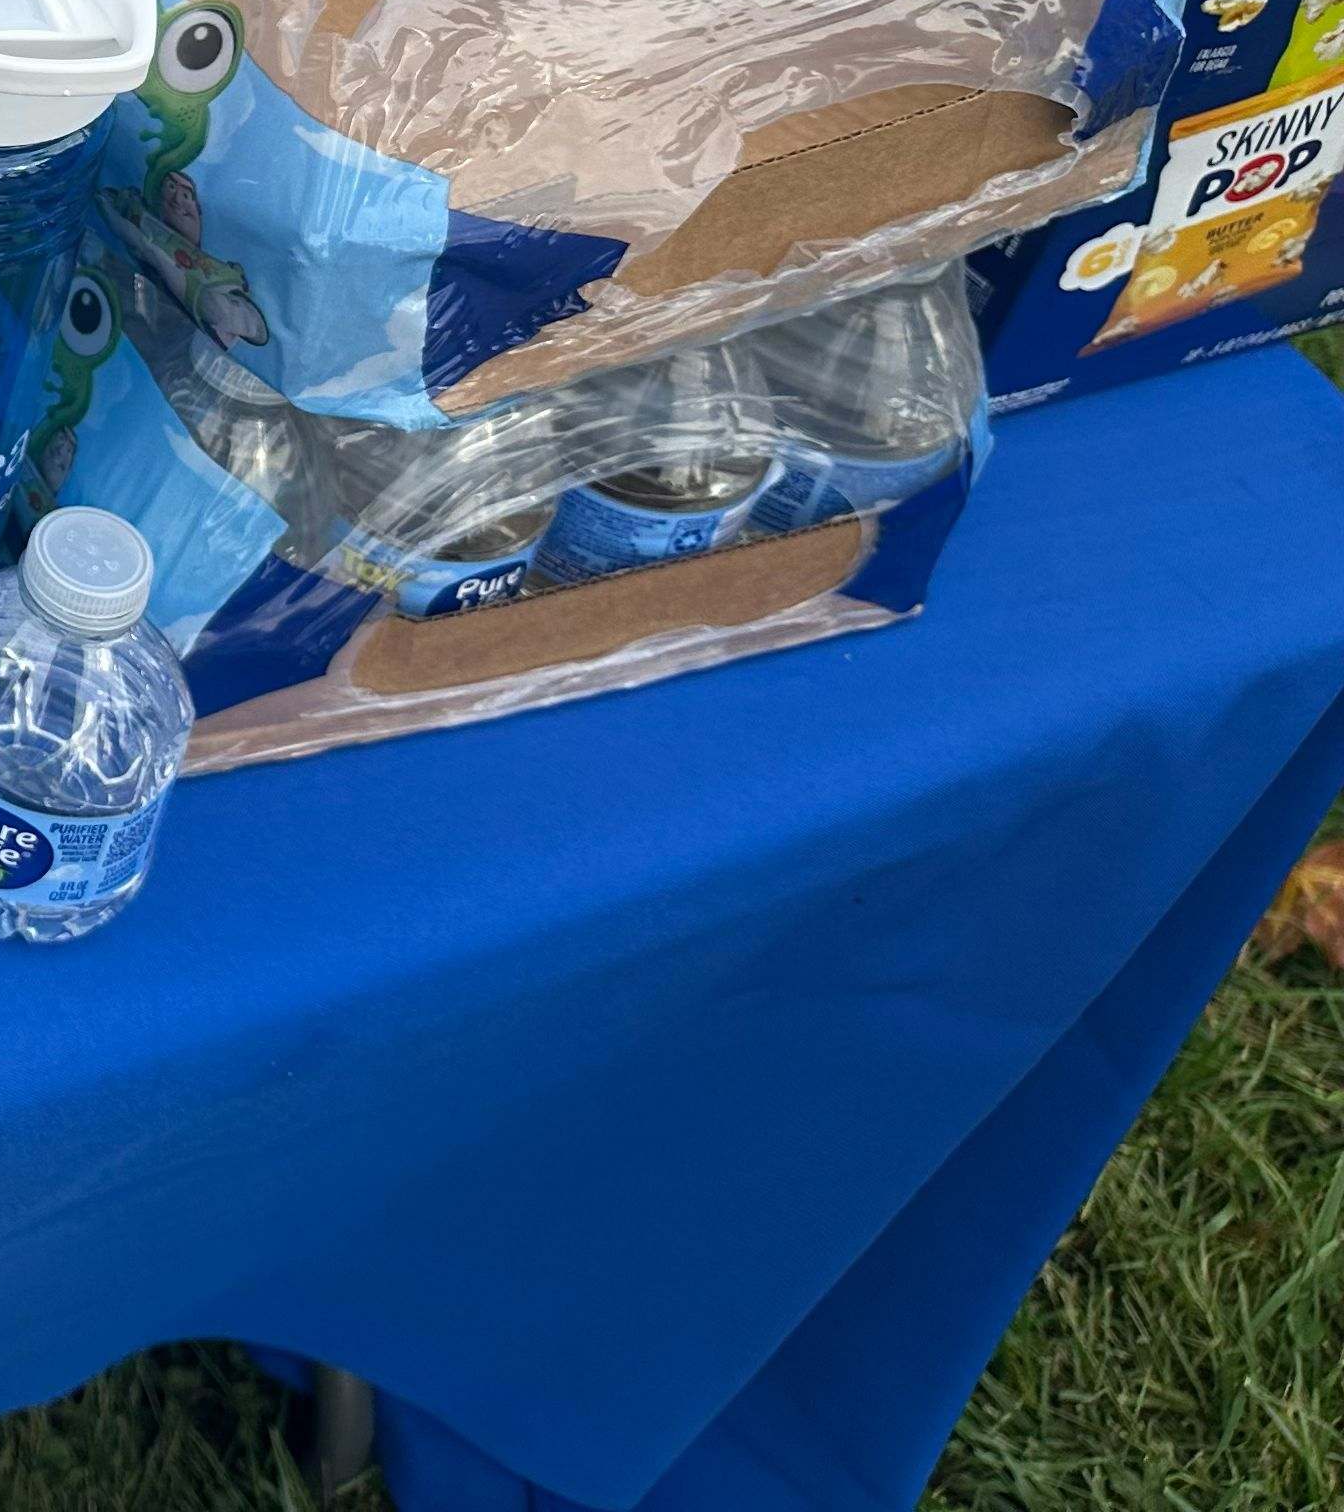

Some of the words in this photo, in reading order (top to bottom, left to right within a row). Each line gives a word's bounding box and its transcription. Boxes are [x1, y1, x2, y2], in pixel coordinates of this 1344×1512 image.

[1186, 139, 1323, 218] POP
[48, 821, 108, 836] PURIFIED
[58, 833, 106, 845] WATER
